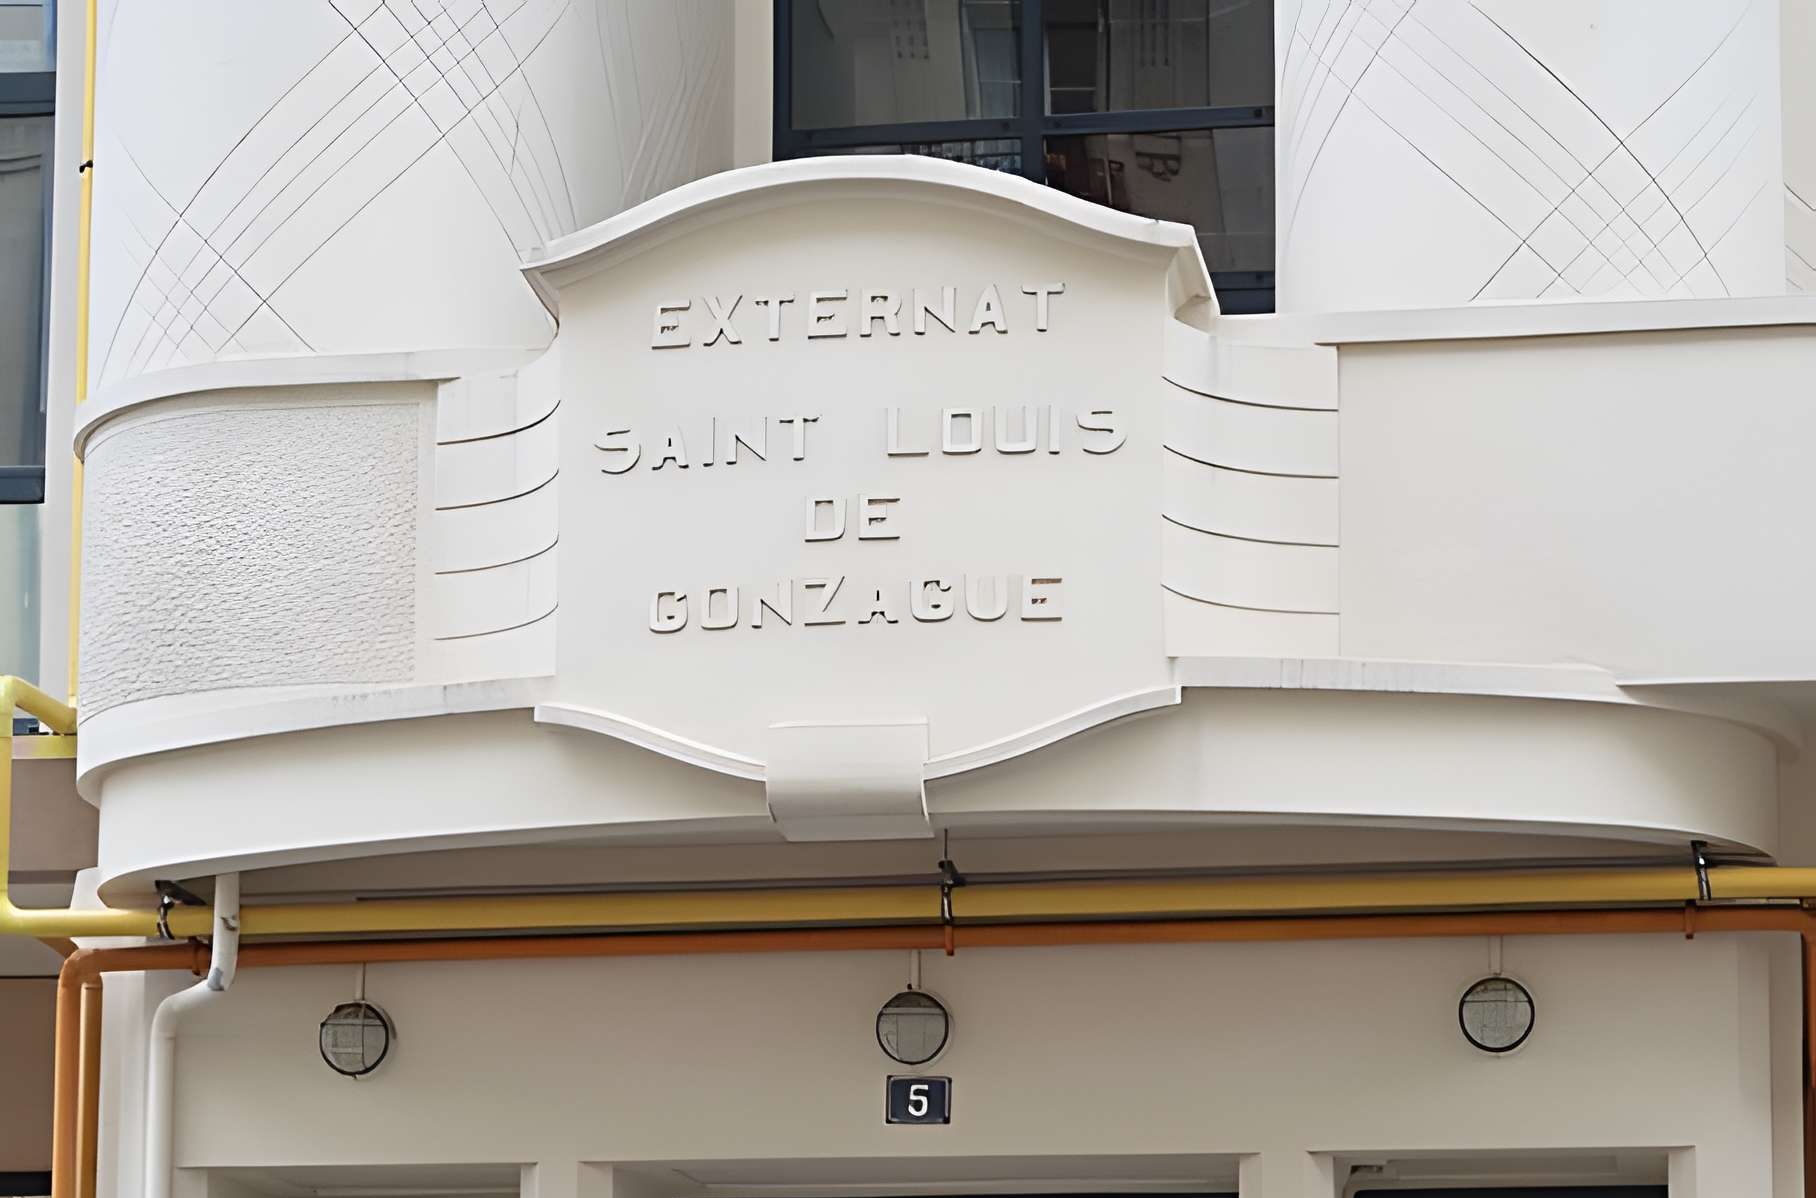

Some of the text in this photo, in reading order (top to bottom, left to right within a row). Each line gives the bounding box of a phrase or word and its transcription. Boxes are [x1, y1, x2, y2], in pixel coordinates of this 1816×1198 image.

[651, 282, 1065, 349] EXTERNAT
[594, 406, 1127, 474] SAINT LOUIS
[804, 493, 900, 542] DE
[648, 575, 1062, 634] GONZAGUE
[908, 1084, 929, 1117] 5
